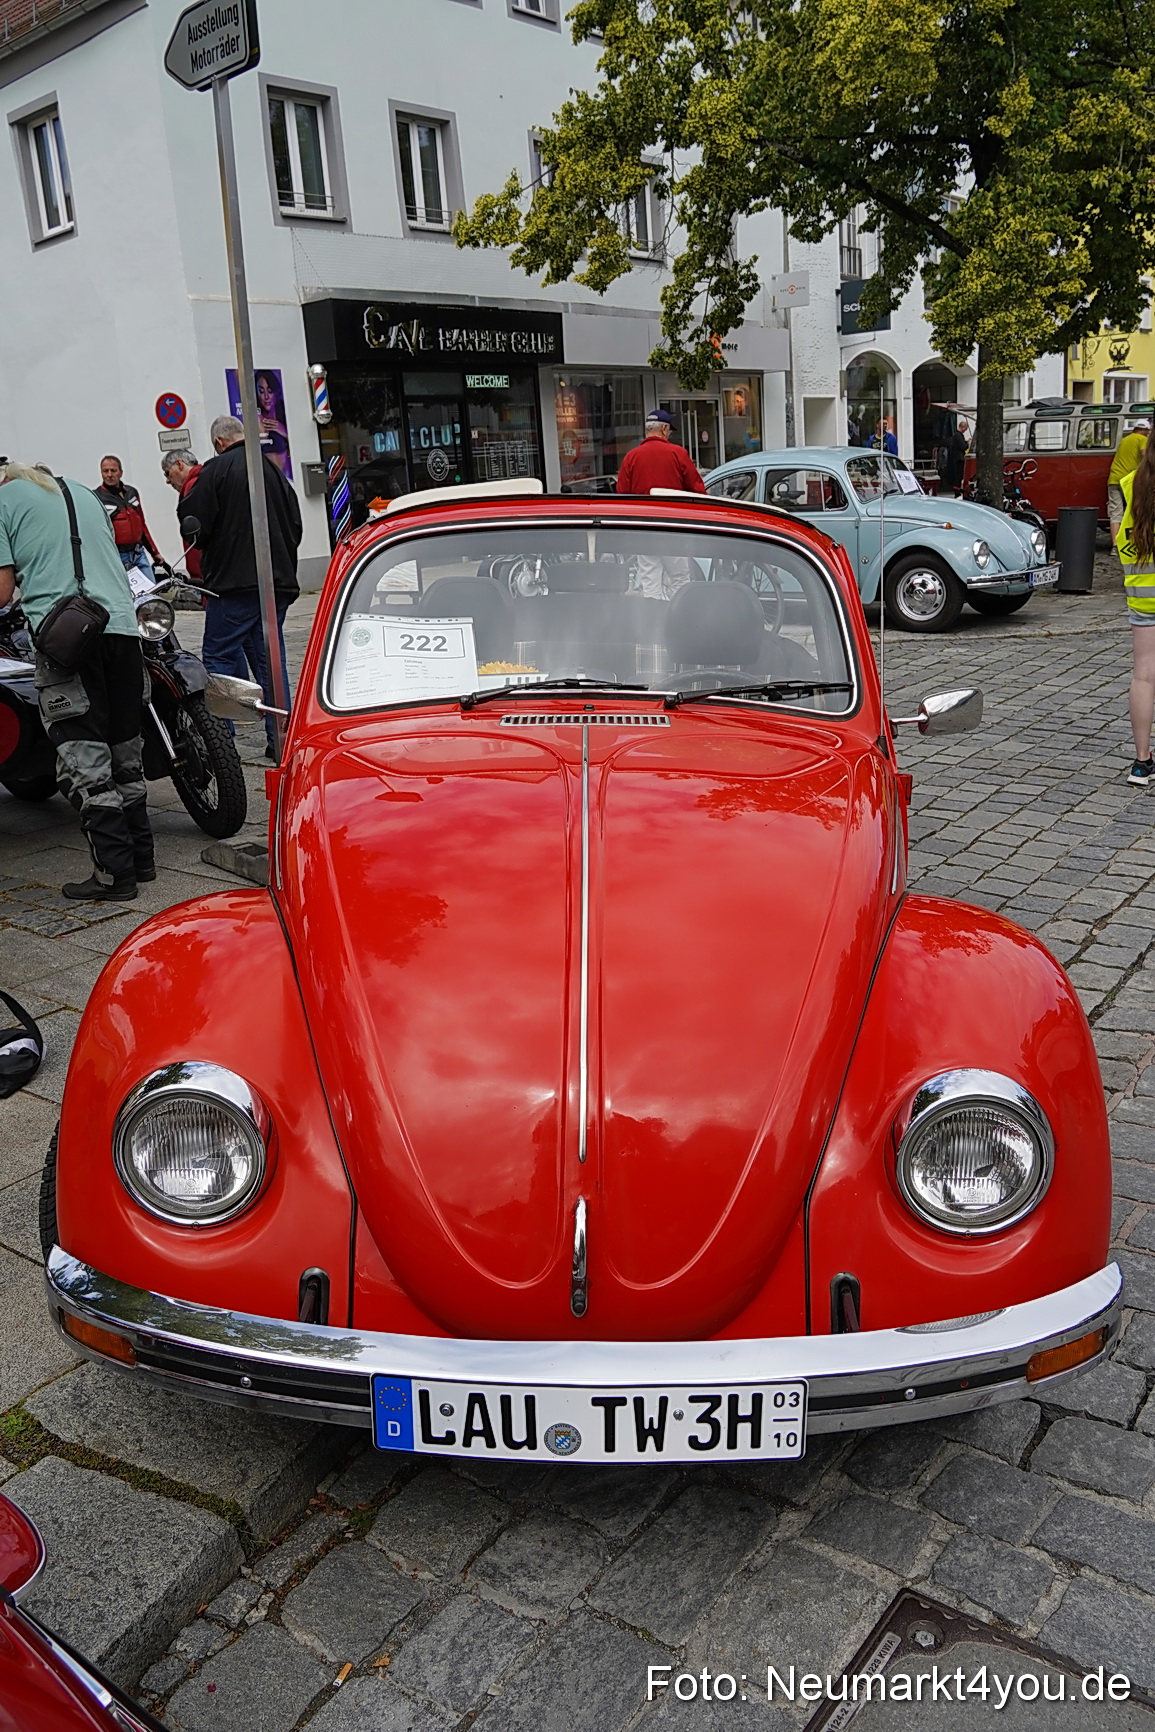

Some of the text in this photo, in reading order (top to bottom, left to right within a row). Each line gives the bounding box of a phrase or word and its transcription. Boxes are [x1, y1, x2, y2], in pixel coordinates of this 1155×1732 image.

[188, 3, 239, 45] Ausstellung
[190, 33, 240, 73] Motorräder
[466, 375, 509, 388] WELCOME
[399, 633, 448, 652] 222
[773, 1391, 800, 1408] 03
[387, 1420, 400, 1436] D
[418, 1389, 538, 1451] LAU
[592, 1396, 668, 1453] TW
[688, 1392, 763, 1450] 3H
[773, 1432, 798, 1448] 10
[878, 1639, 896, 1659] KIWA
